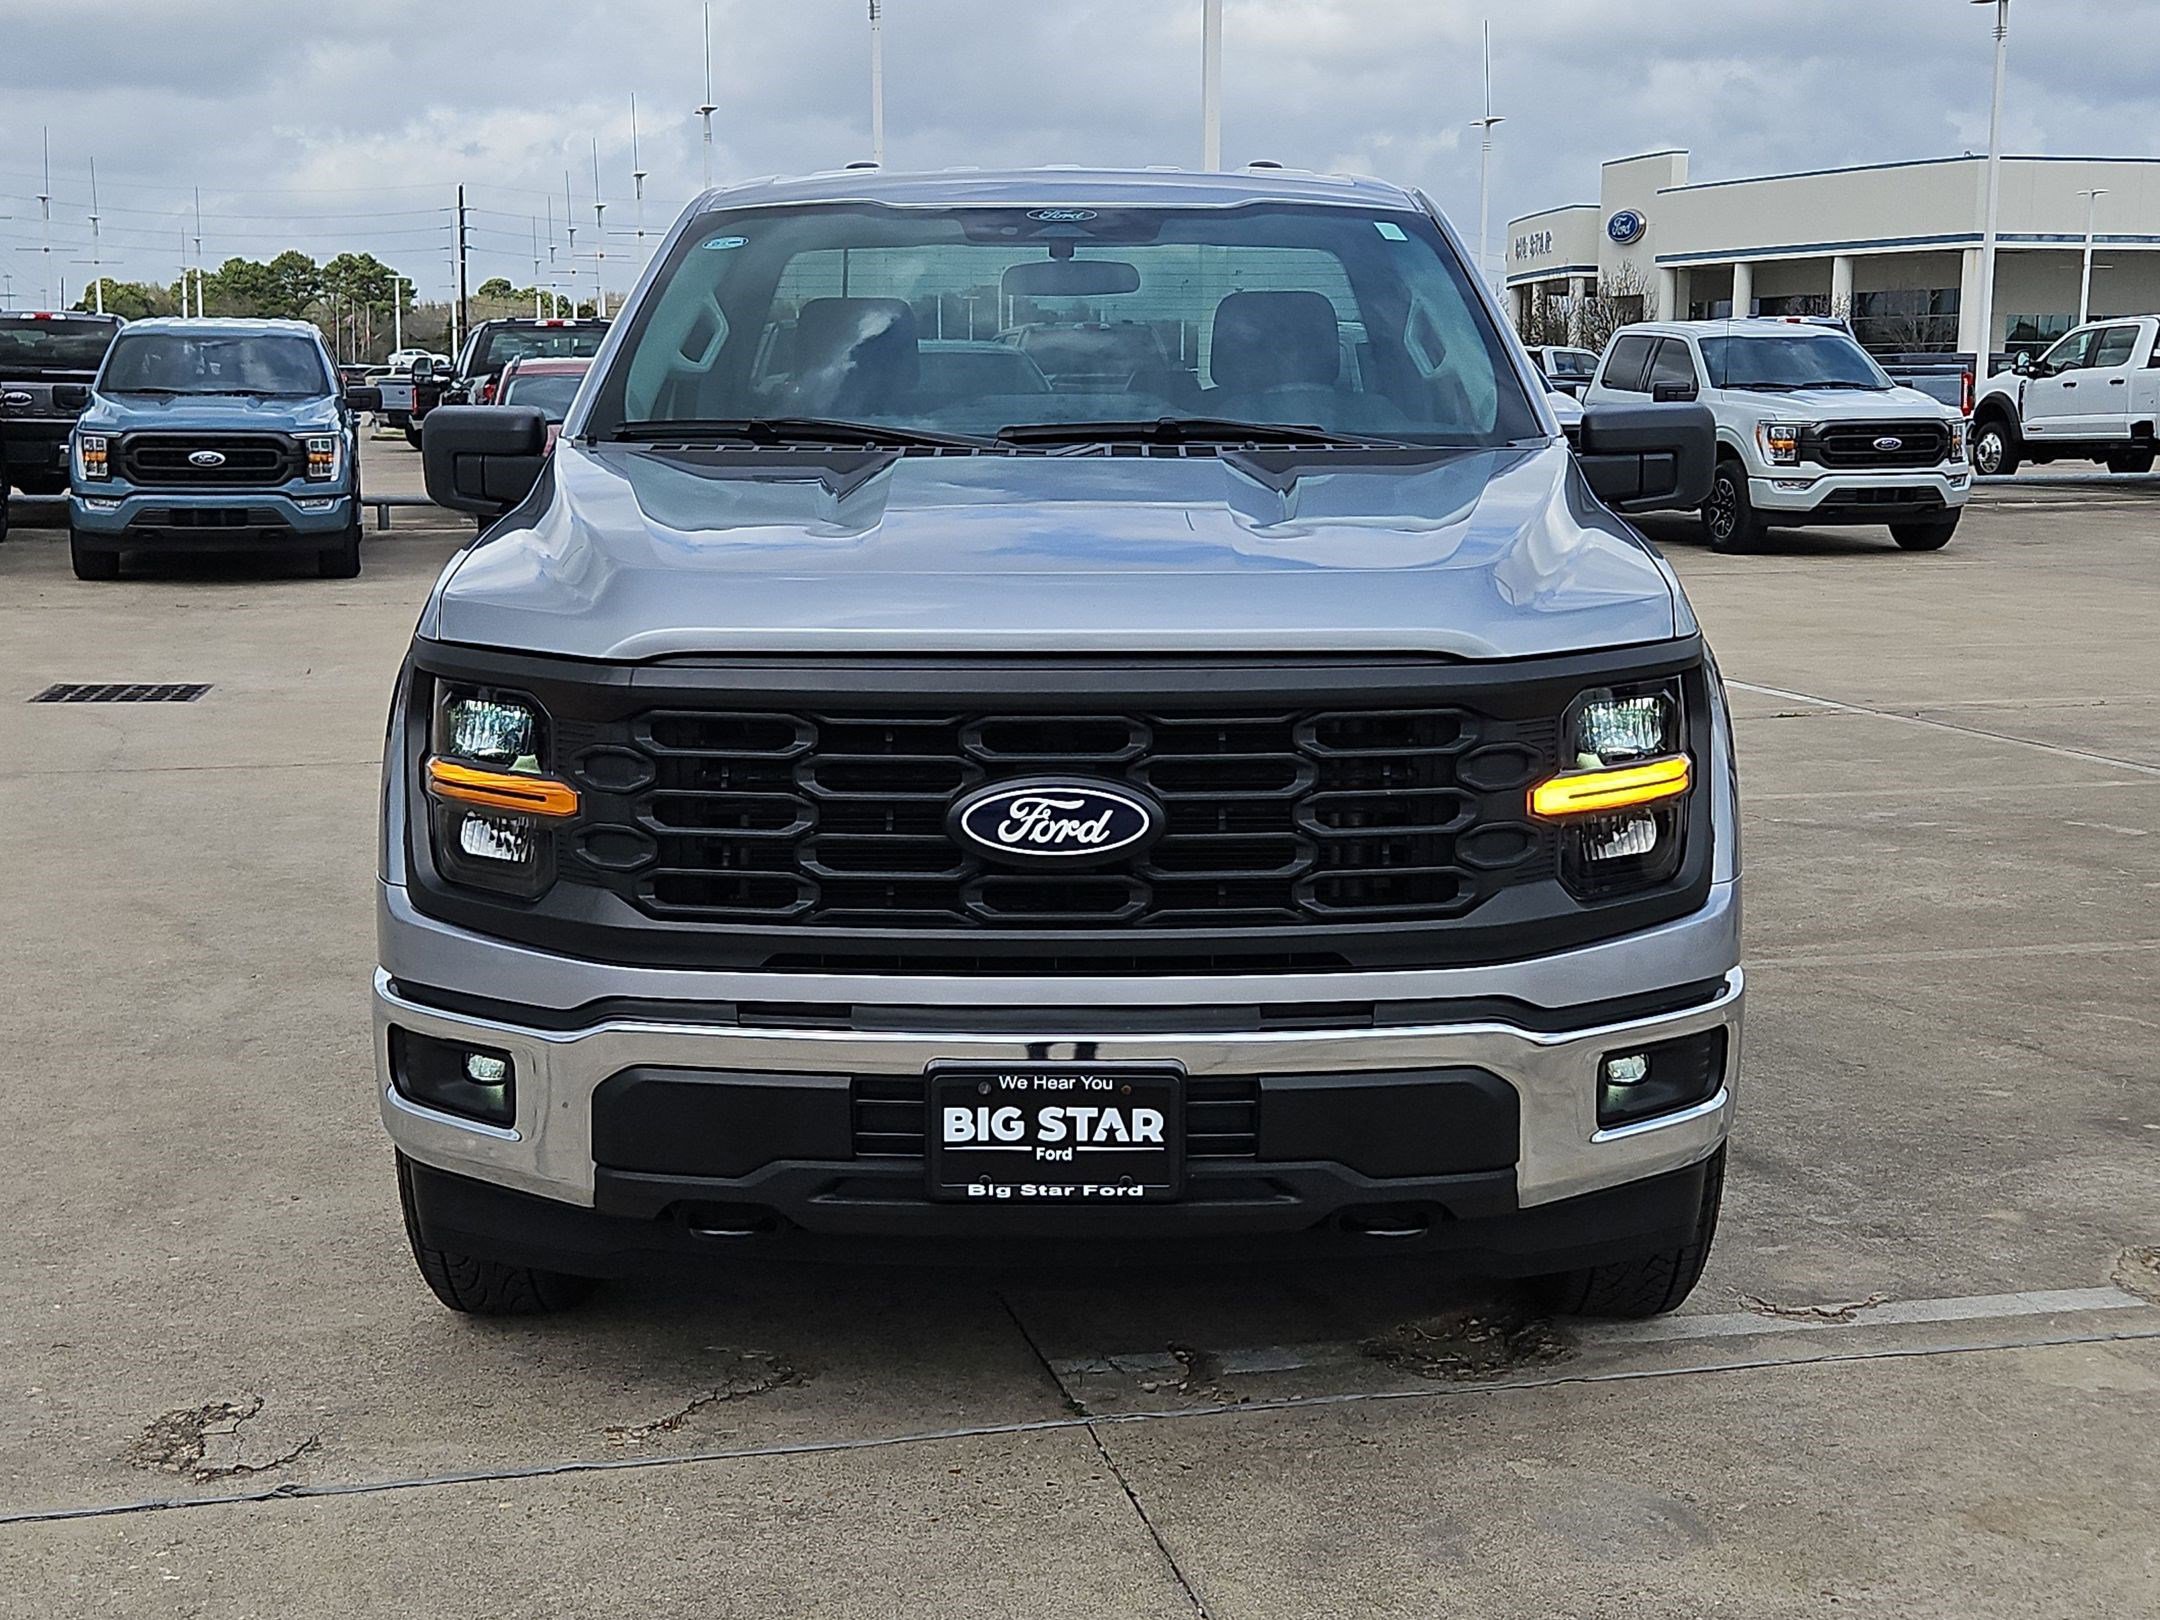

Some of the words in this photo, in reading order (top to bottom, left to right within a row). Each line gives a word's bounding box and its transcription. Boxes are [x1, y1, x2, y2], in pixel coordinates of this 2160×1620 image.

[1039, 208, 1085, 220] Ford
[1612, 216, 1632, 236] Ford
[998, 797, 1114, 844] Ford
[999, 1076, 1028, 1090] We
[1034, 1076, 1076, 1090] Hear
[1081, 1076, 1113, 1090] You
[943, 1106, 1026, 1142] BIG
[1037, 1106, 1165, 1142] STAR
[1036, 1147, 1073, 1161] Ford
[968, 1184, 1011, 1198] Big
[1020, 1184, 1075, 1196] Star
[1083, 1184, 1144, 1196] Ford
